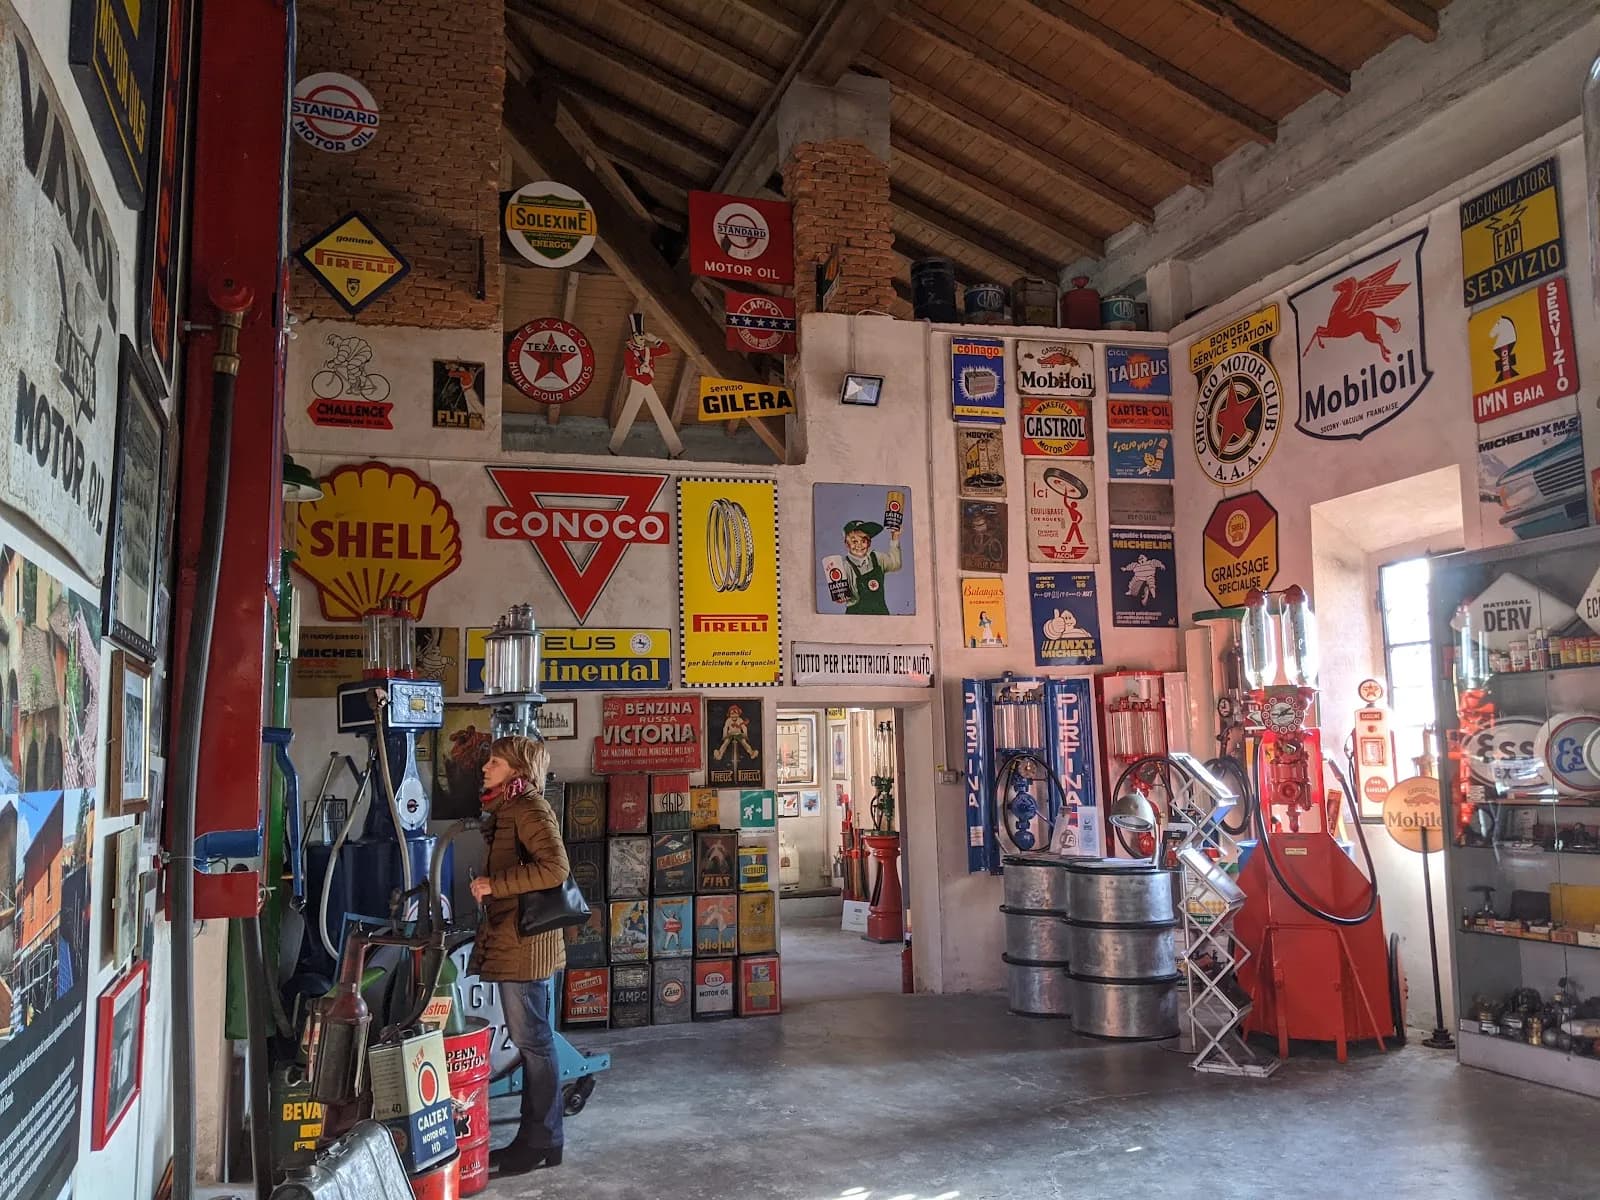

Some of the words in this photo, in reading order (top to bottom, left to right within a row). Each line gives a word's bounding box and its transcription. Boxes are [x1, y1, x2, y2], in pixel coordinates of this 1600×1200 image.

[128, 71, 146, 155] OILS
[291, 101, 378, 125] STANDARD
[295, 120, 346, 151] MOTOR
[351, 130, 374, 148] OIL
[1461, 166, 1552, 226] ACCUMULATORI
[516, 208, 587, 231] SOLEXINE
[717, 223, 766, 239] STANDARD
[336, 235, 374, 245] gomme
[1496, 226, 1519, 259] FAP
[315, 248, 396, 274] PIRELLI
[704, 260, 753, 276] MOTOR
[758, 267, 780, 280] OIL
[1466, 243, 1561, 302] SERVIZIO
[743, 300, 779, 316] LAMPO
[514, 322, 588, 348] TEXACO
[1193, 340, 1230, 370] SERVICE
[1231, 322, 1274, 352] STATION
[1210, 321, 1251, 348] BONDED
[1546, 282, 1570, 392] SERVIZIO
[527, 342, 576, 353] TEXACO
[956, 344, 1000, 358] colnago
[508, 361, 529, 393] HUILE
[533, 389, 564, 402] POUR
[568, 365, 593, 399] AUTOS
[1021, 370, 1093, 390] Mobiloil
[1109, 359, 1168, 383] TAURUS
[710, 384, 743, 392] servizio
[1305, 349, 1416, 423] Mobiloil
[317, 403, 385, 417] CHALLENGE
[702, 390, 793, 415] GILERA
[1037, 400, 1073, 415] WAKEFIELD
[1197, 374, 1219, 455] CHICAGO
[1221, 355, 1266, 380] MOTOR
[1263, 379, 1278, 432] CLUB
[1477, 388, 1508, 417] IMN
[1513, 384, 1545, 407] BAIA
[1026, 416, 1085, 438] CASTROL
[15, 369, 85, 499] MOTOR
[87, 461, 103, 537] OIL
[1038, 440, 1064, 454] MOTOR
[1063, 440, 1076, 452] OIL
[1478, 429, 1541, 453] MICHELIN
[493, 511, 665, 541] CONOCO
[310, 519, 441, 561] SHELL
[1112, 540, 1173, 550] MICHELIN
[1211, 555, 1269, 583] GRAISSAGE
[1218, 574, 1261, 596] SPECIALISE
[1482, 598, 1531, 609] NATIONAL
[1586, 597, 1600, 622] EC
[693, 613, 769, 633] PIRELLI
[1484, 606, 1532, 632] DERV
[298, 648, 382, 658] MICHEL
[544, 636, 616, 650] EUS
[1041, 649, 1096, 659] MICHELIN
[795, 653, 820, 673] TUTTO
[824, 654, 839, 673] PER
[625, 702, 693, 715] BENZINA
[603, 723, 696, 745] VICTORIA
[965, 693, 980, 808] PURFINA
[1056, 693, 1083, 805] PURFINA
[1477, 733, 1535, 764] Ess
[1556, 737, 1588, 774] Es
[1388, 811, 1442, 828] Mobil
[703, 876, 730, 888] FIAT
[424, 1001, 450, 1017] astrol
[412, 1046, 426, 1073] NEW
[417, 1106, 449, 1132] CALTEX
[422, 1131, 439, 1144] MOTOR
[431, 1142, 441, 1154] HD
